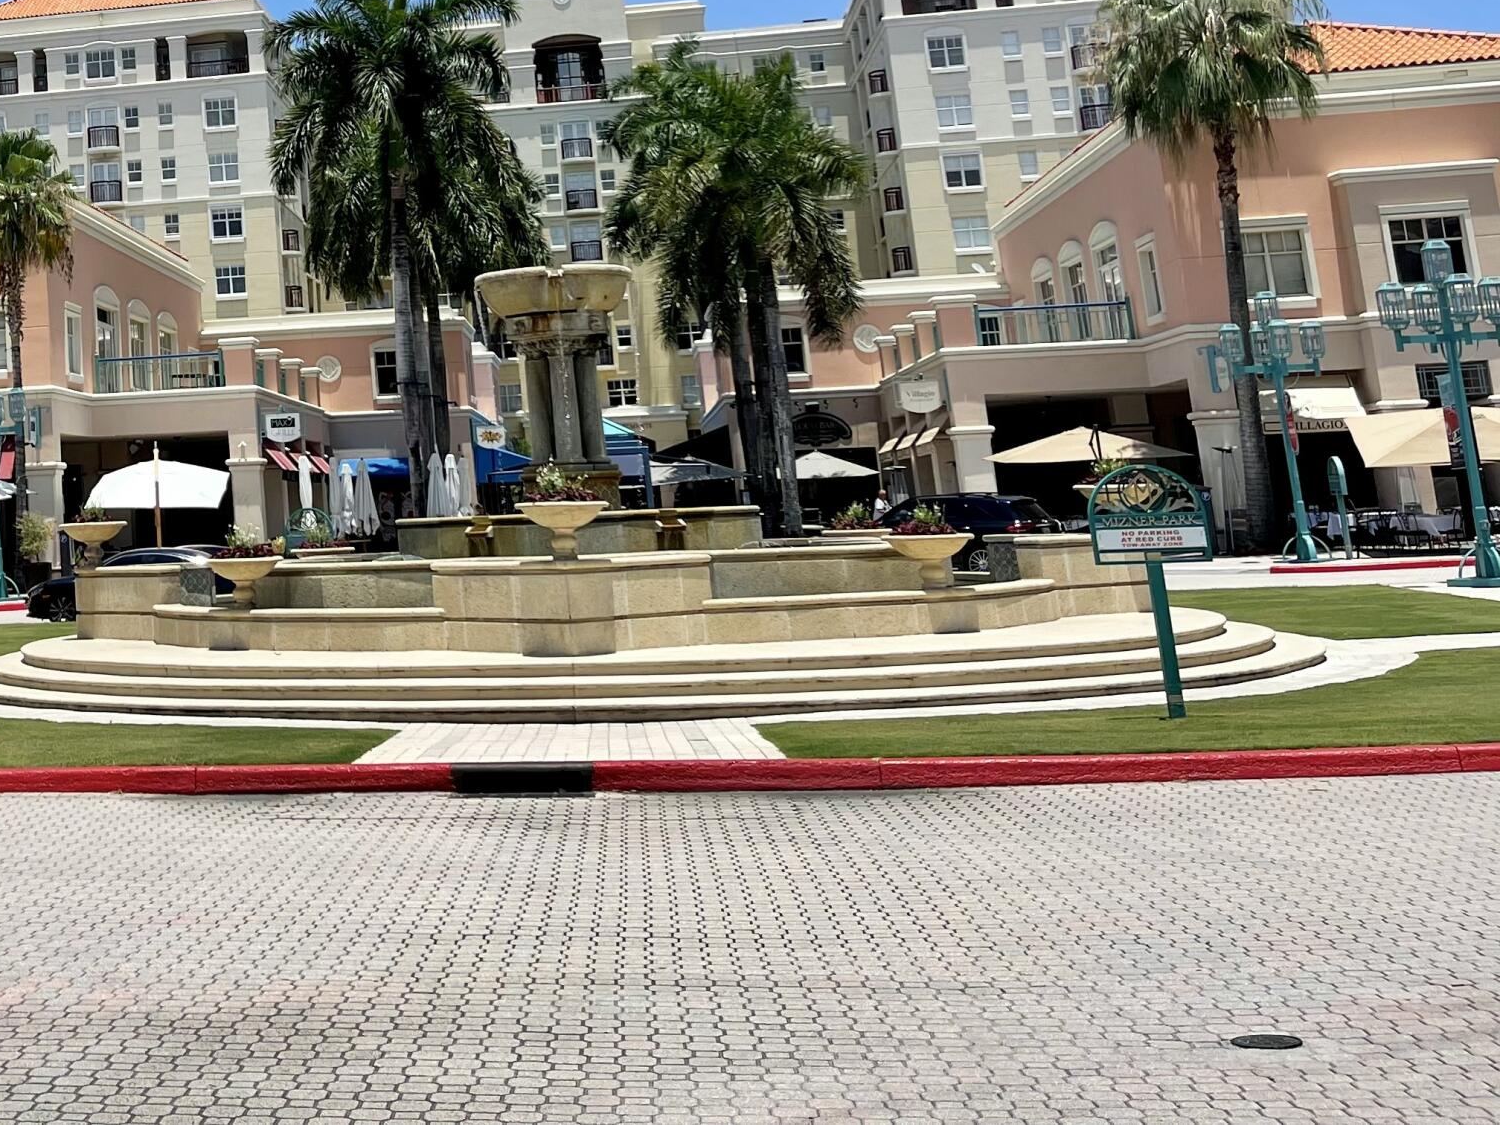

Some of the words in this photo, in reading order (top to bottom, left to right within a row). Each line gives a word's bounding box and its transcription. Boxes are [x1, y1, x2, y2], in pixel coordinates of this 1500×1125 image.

[1295, 420, 1343, 430] ILLAGIO
[1102, 516, 1157, 527] MIZNER
[1162, 514, 1197, 525] PARK
